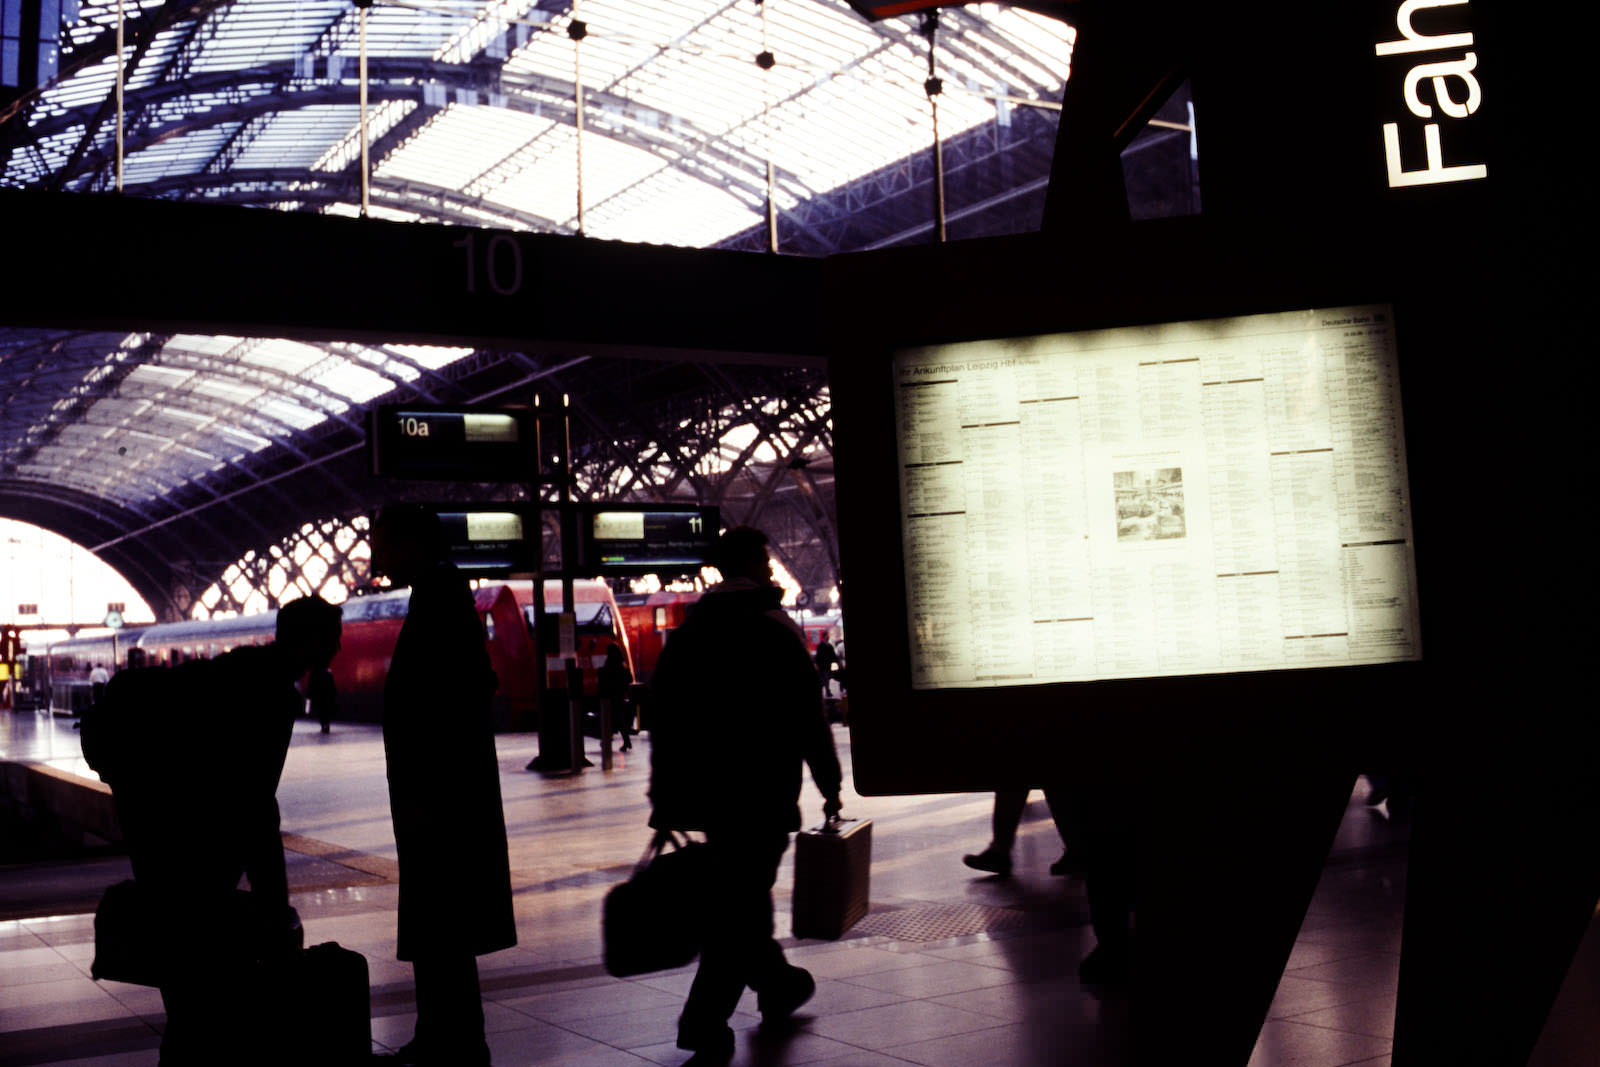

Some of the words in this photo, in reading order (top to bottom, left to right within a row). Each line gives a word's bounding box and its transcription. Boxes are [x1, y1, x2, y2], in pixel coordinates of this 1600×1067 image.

[1375, 0, 1487, 188] Fah
[452, 231, 523, 295] 10
[913, 364, 965, 376] Ankunftplan
[967, 360, 998, 371] Leipzig
[398, 417, 429, 437] 10a
[688, 516, 703, 534] 11
